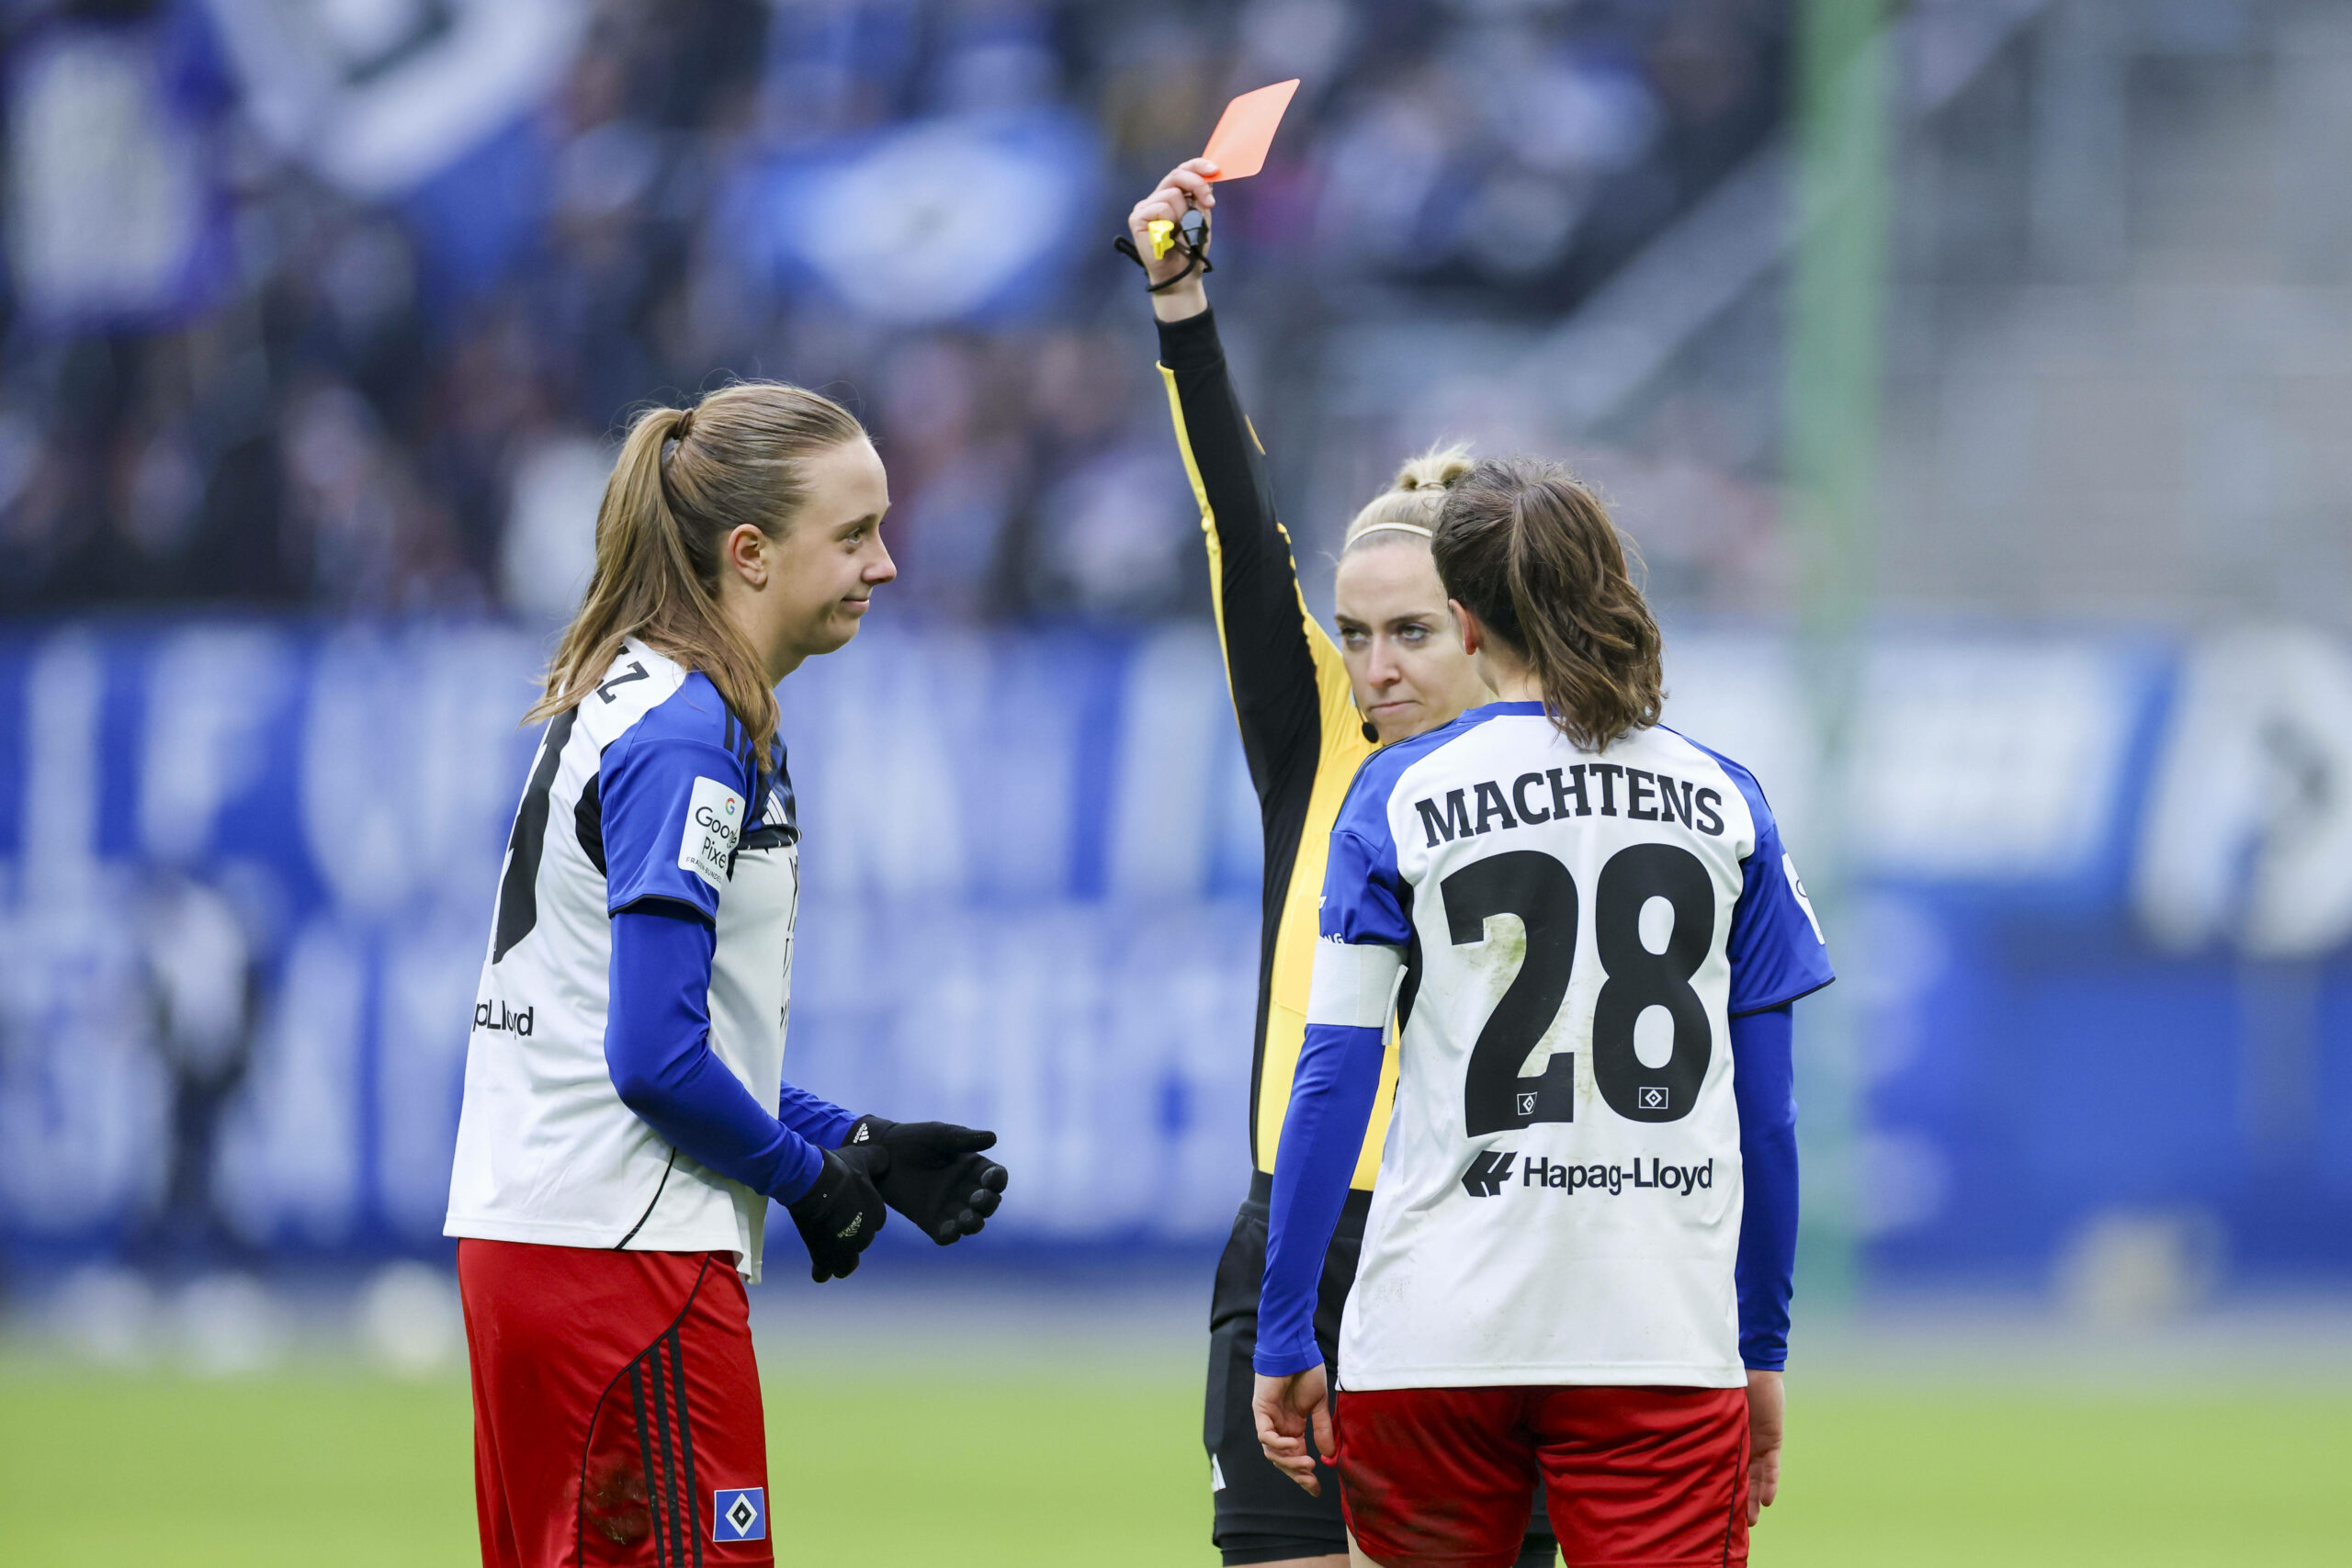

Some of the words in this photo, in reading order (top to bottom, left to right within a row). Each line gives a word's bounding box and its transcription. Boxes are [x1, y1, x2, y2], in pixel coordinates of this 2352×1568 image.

[1415, 763, 1724, 848] MACHTENS
[1441, 843, 1714, 1138] 28
[1523, 1156, 1713, 1196] Hapag-Lloyd
